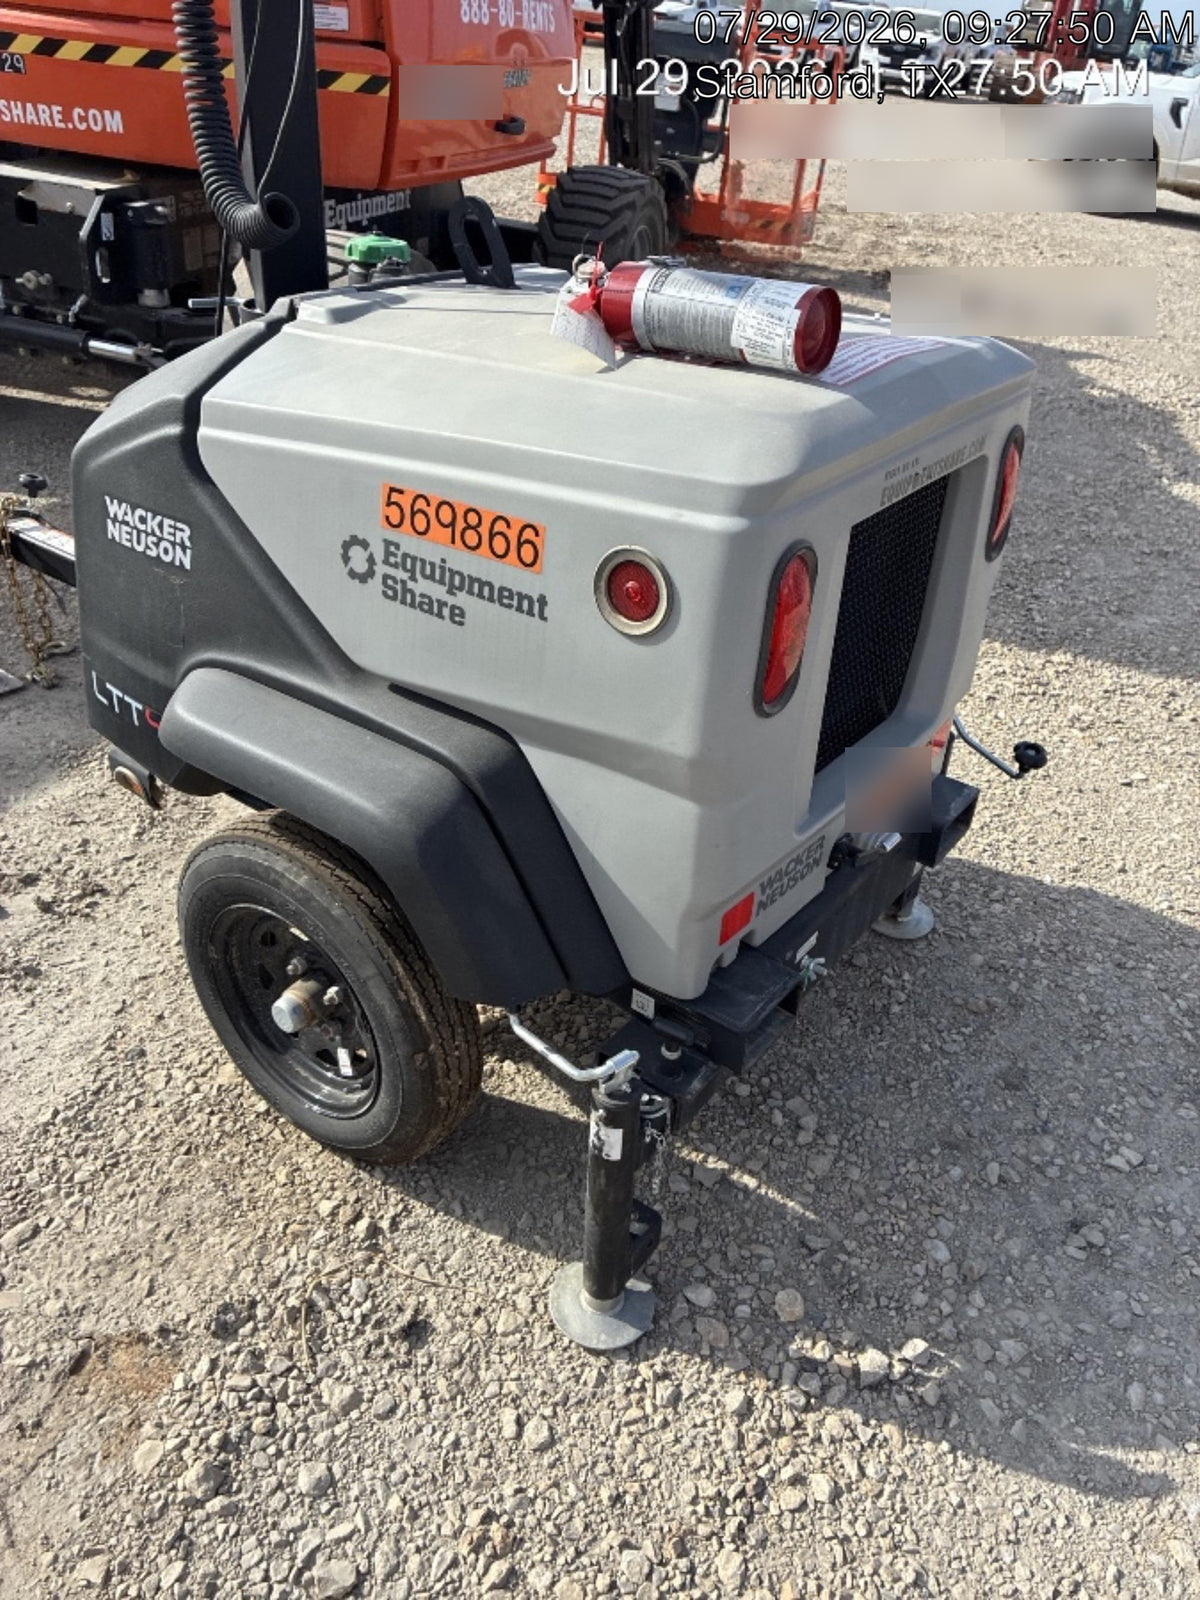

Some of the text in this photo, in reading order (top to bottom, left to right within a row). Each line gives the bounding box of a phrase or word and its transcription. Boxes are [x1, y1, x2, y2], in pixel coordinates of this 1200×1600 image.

[460, 0, 555, 33] 888-80-RENTS
[323, 187, 412, 231] Equipment
[104, 495, 192, 548] WACKER
[107, 518, 192, 570] NEUSON
[384, 487, 541, 568] 569866
[381, 573, 466, 626] Share
[382, 538, 548, 623] Equipment
[755, 852, 824, 918] NEUSON
[759, 834, 826, 896] WACKER
